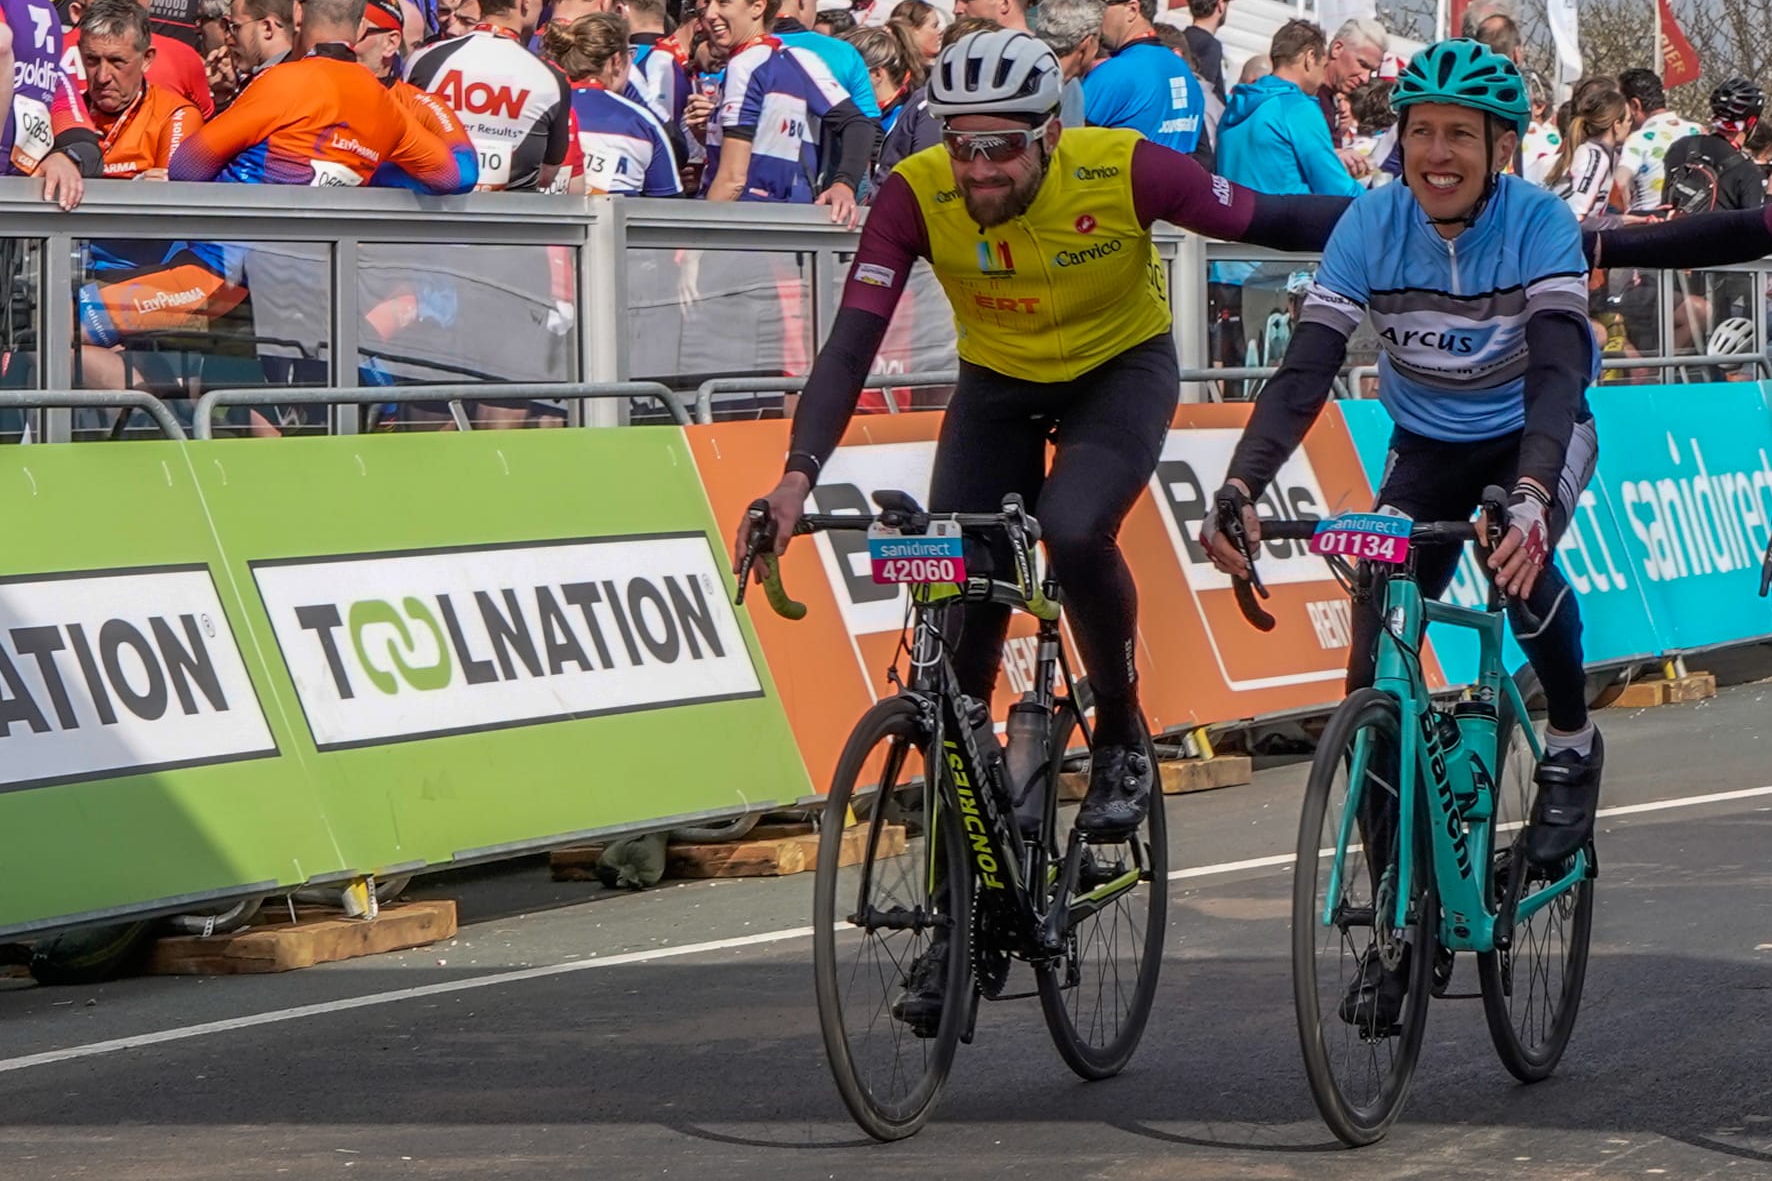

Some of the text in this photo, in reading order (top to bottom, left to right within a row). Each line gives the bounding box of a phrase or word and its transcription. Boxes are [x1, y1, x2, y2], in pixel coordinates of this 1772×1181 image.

[1078, 166, 1119, 181] Carvico
[1055, 239, 1122, 268] Carvico
[1380, 326, 1473, 353] Arcus
[880, 541, 950, 558] sanidirect
[1319, 532, 1396, 559] 01134
[882, 559, 955, 582] 42060
[294, 574, 726, 699] TOOLNATION
[1417, 705, 1474, 880] Bianchi
